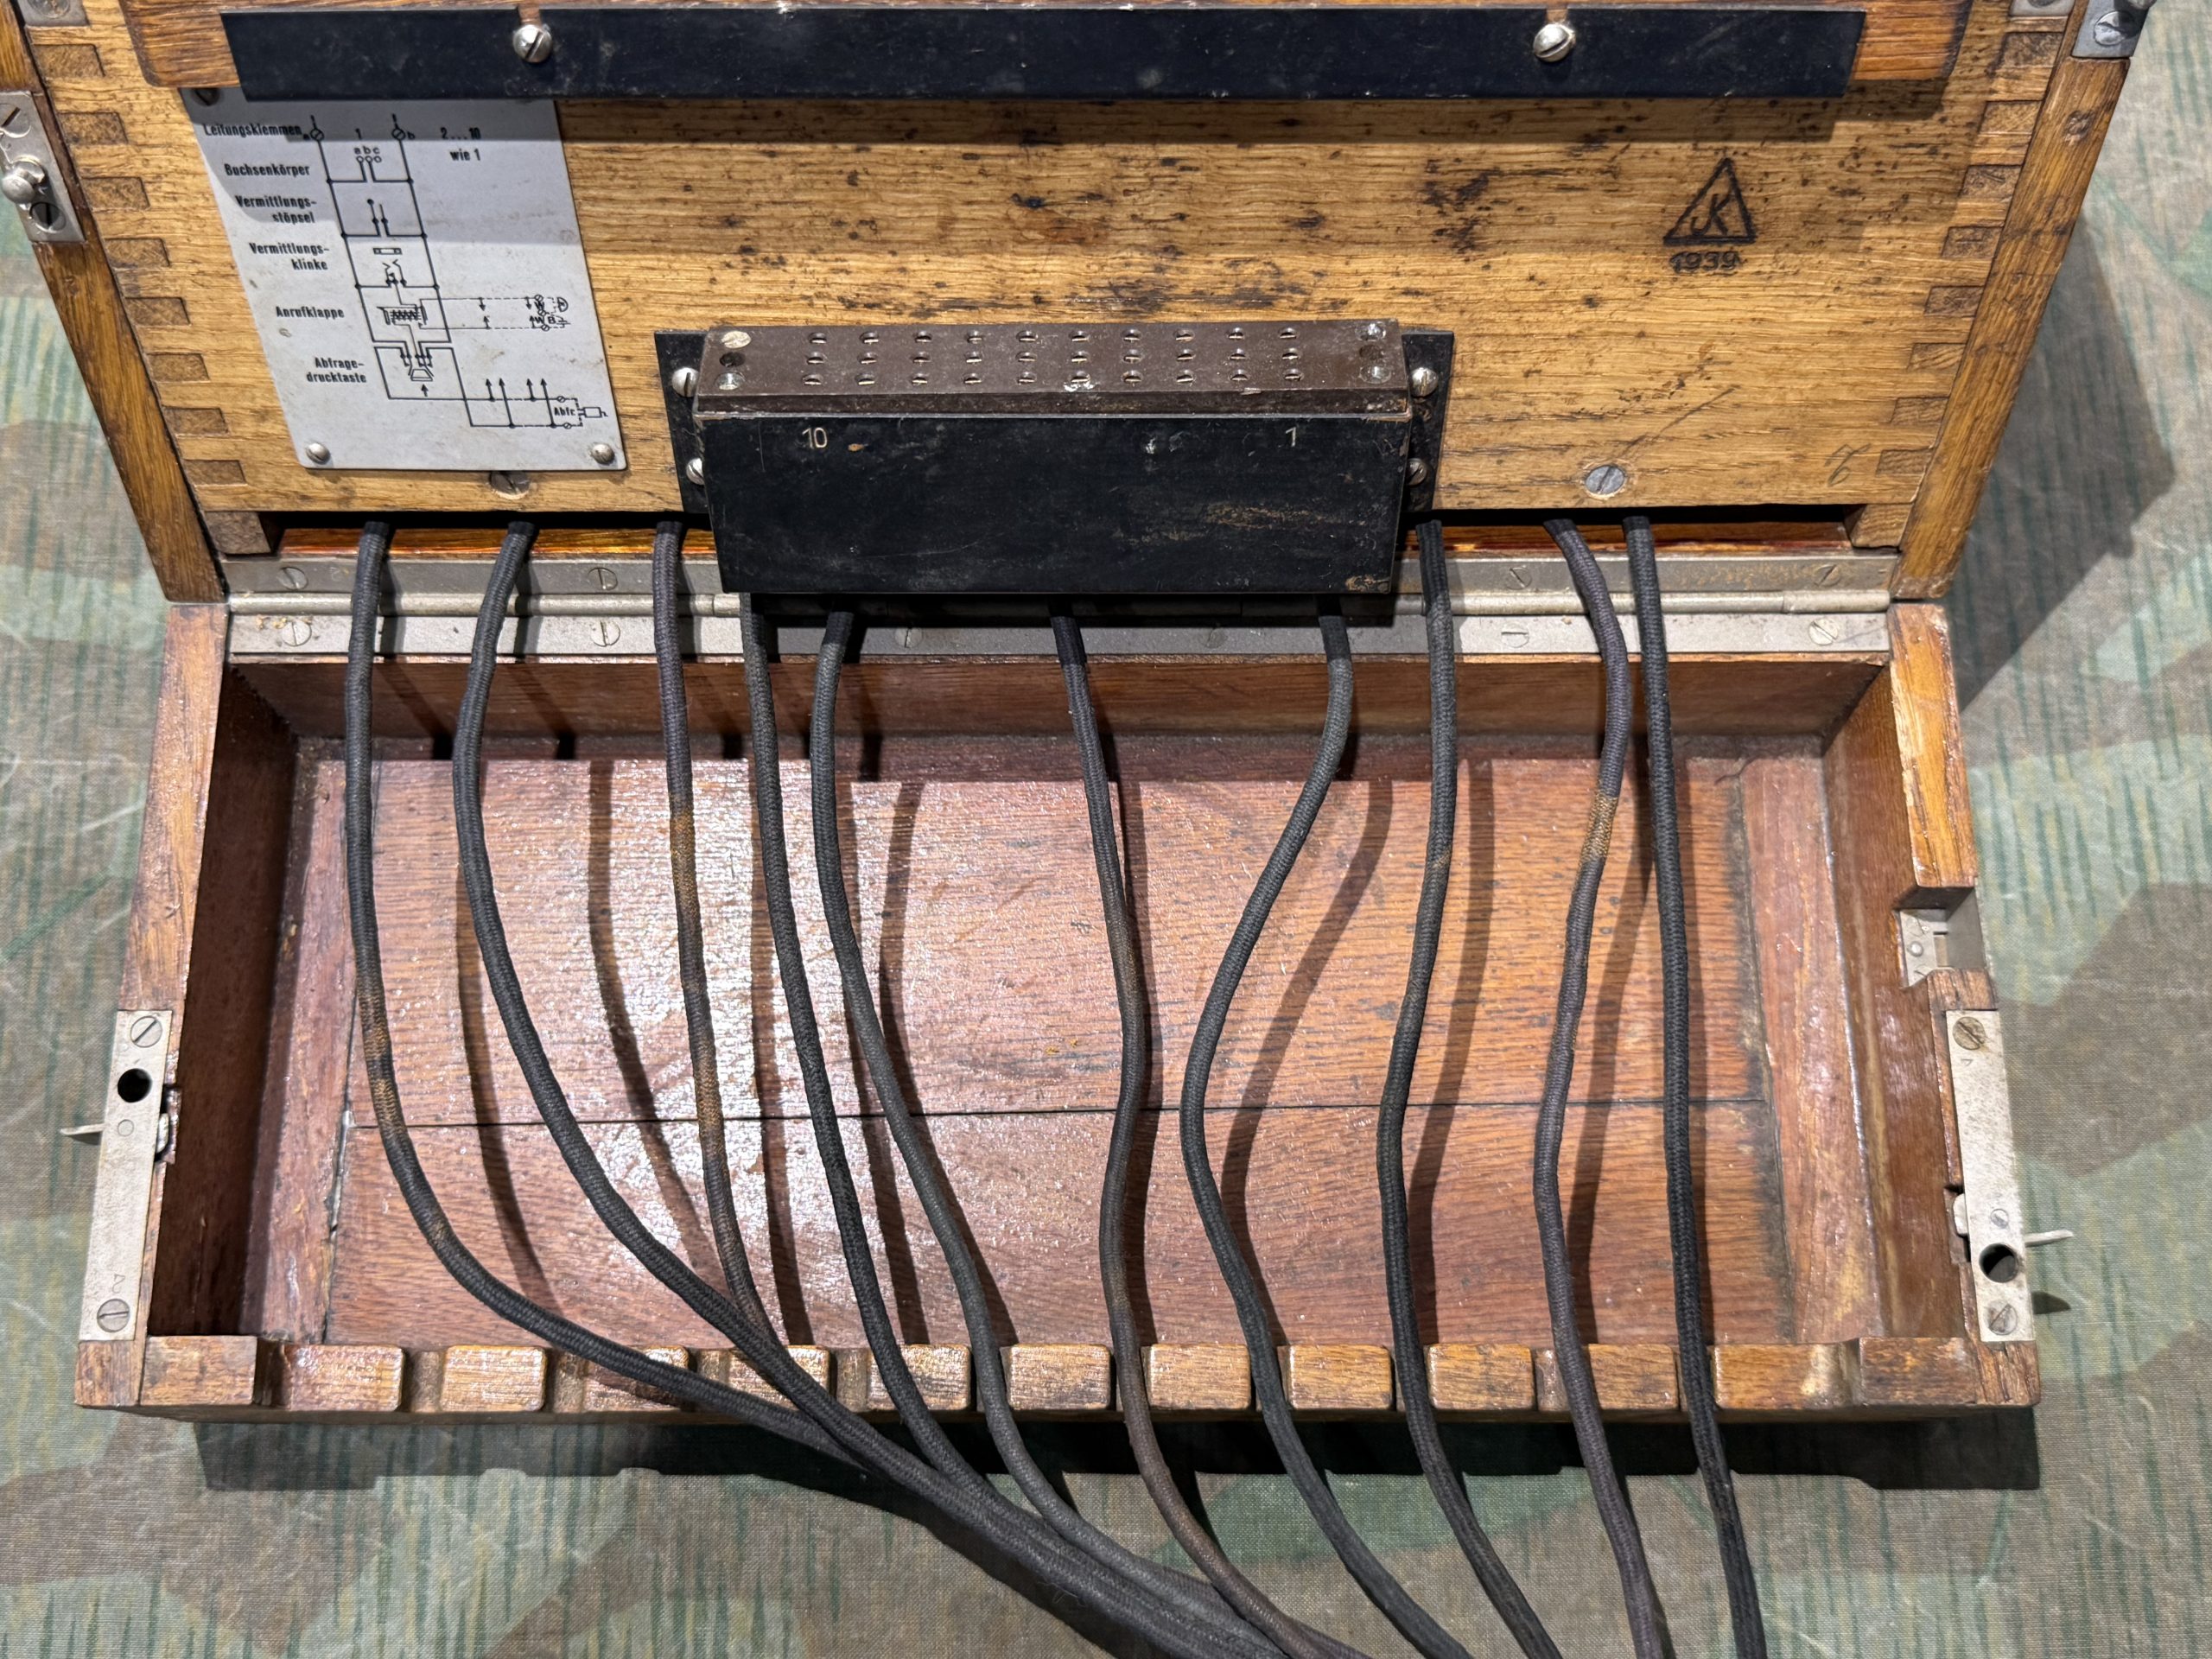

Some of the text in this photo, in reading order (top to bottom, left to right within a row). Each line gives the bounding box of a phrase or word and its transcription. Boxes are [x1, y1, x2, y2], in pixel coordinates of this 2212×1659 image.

[203, 124, 302, 137] Leitungsklemmen
[363, 145, 371, 155] b
[450, 149, 481, 161] wie 1
[224, 163, 310, 176] Buchsenkörper
[235, 194, 317, 209] Vermittlungs-
[272, 211, 315, 225] stöpsel
[249, 242, 330, 257] Vermittlungs-
[291, 258, 328, 270] klinke
[1669, 251, 1742, 273] 1939
[276, 306, 345, 320] Anrufklappe
[315, 357, 365, 371] Abfrage-
[306, 372, 367, 383] drucktaste
[802, 427, 828, 449] 10
[1285, 426, 1297, 448] 1
